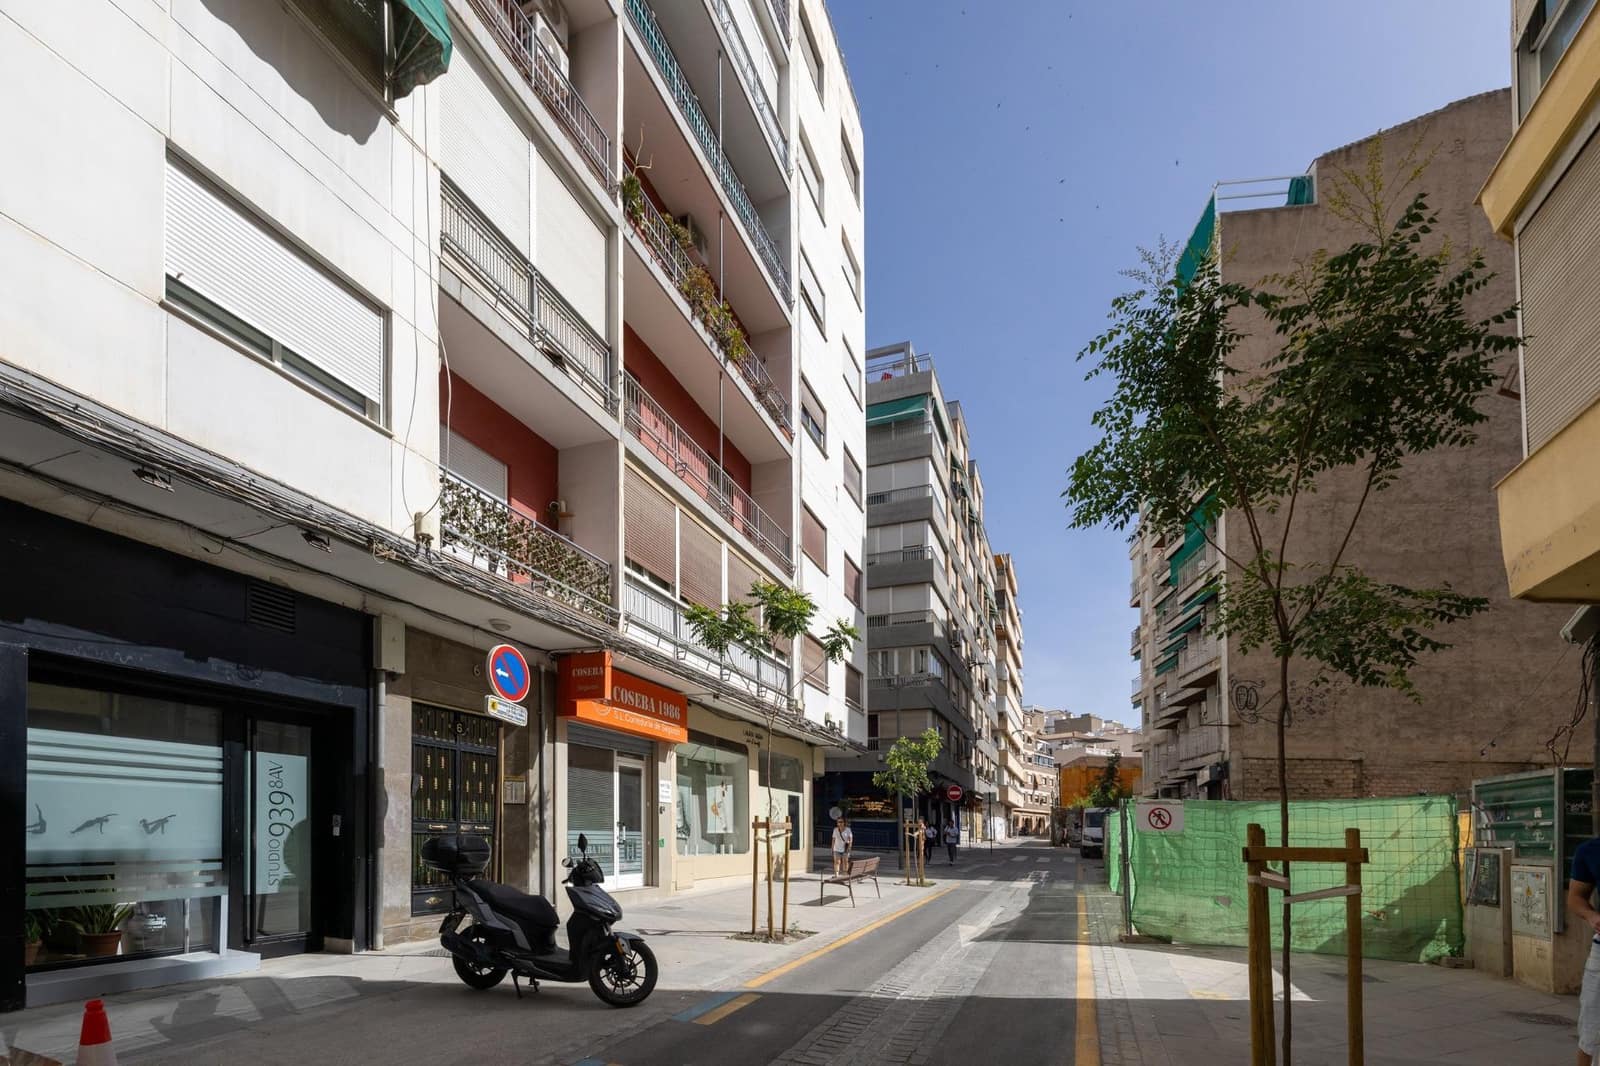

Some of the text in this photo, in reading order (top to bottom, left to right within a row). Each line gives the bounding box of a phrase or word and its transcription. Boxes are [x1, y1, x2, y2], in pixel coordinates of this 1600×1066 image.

[474, 665, 480, 677] 6
[572, 667, 604, 678] COSEBA
[613, 686, 681, 720] COSEBA 1986
[456, 723, 463, 733] 6
